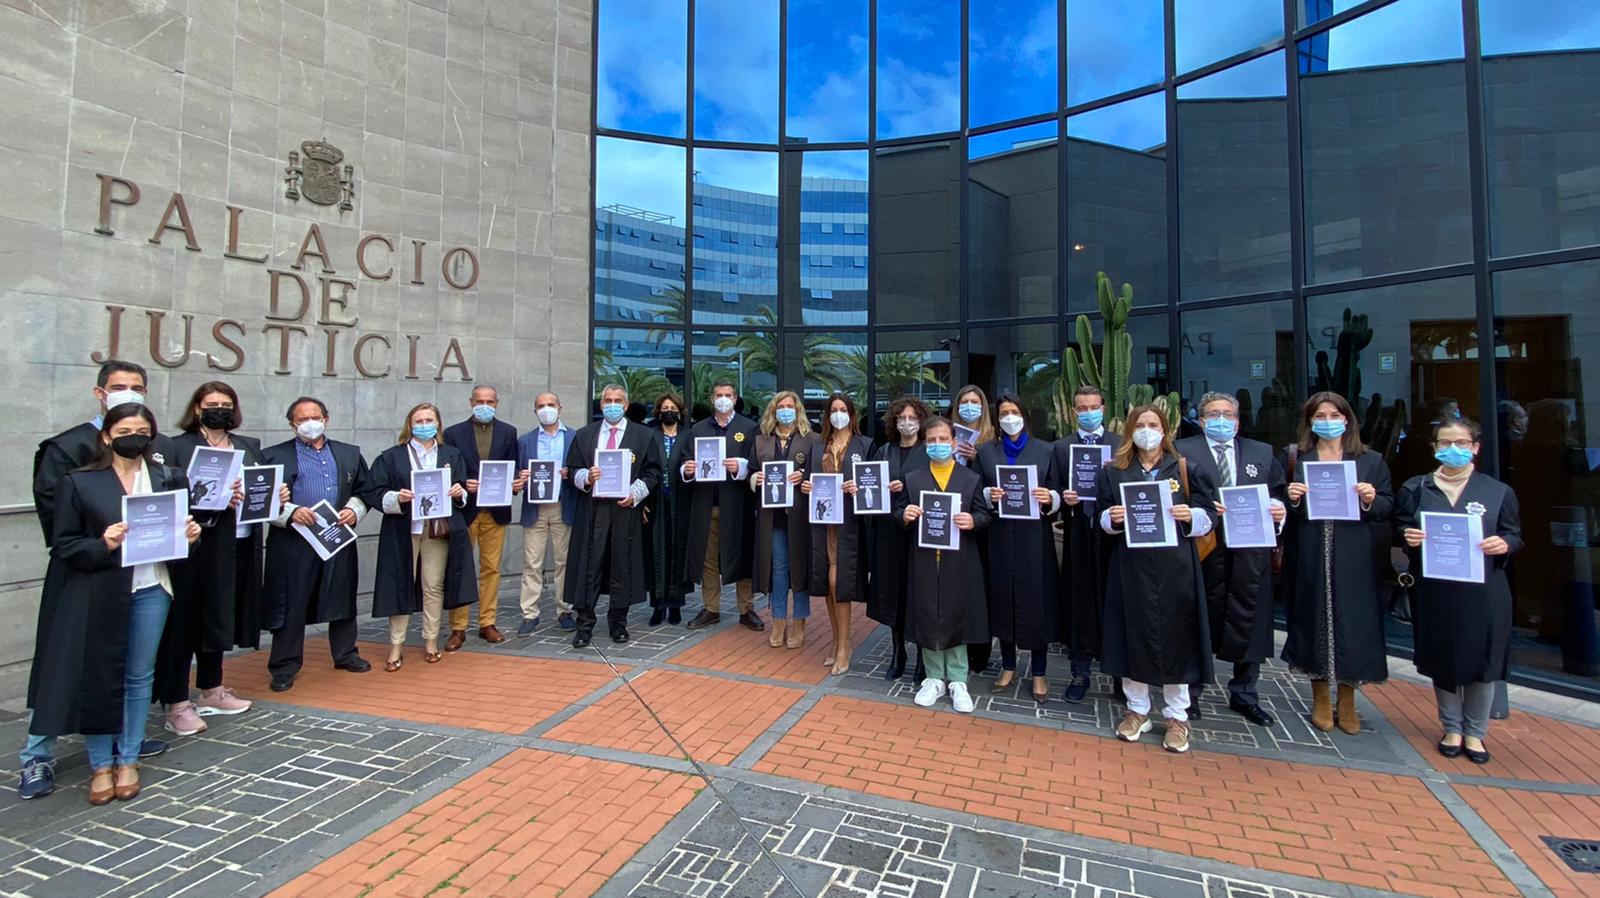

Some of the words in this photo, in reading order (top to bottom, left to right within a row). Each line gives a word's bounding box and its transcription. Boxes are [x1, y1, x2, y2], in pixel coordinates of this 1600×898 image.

[94, 173, 480, 289] PALACIO
[265, 269, 359, 327] DE
[91, 305, 473, 382] JUSTICIA
